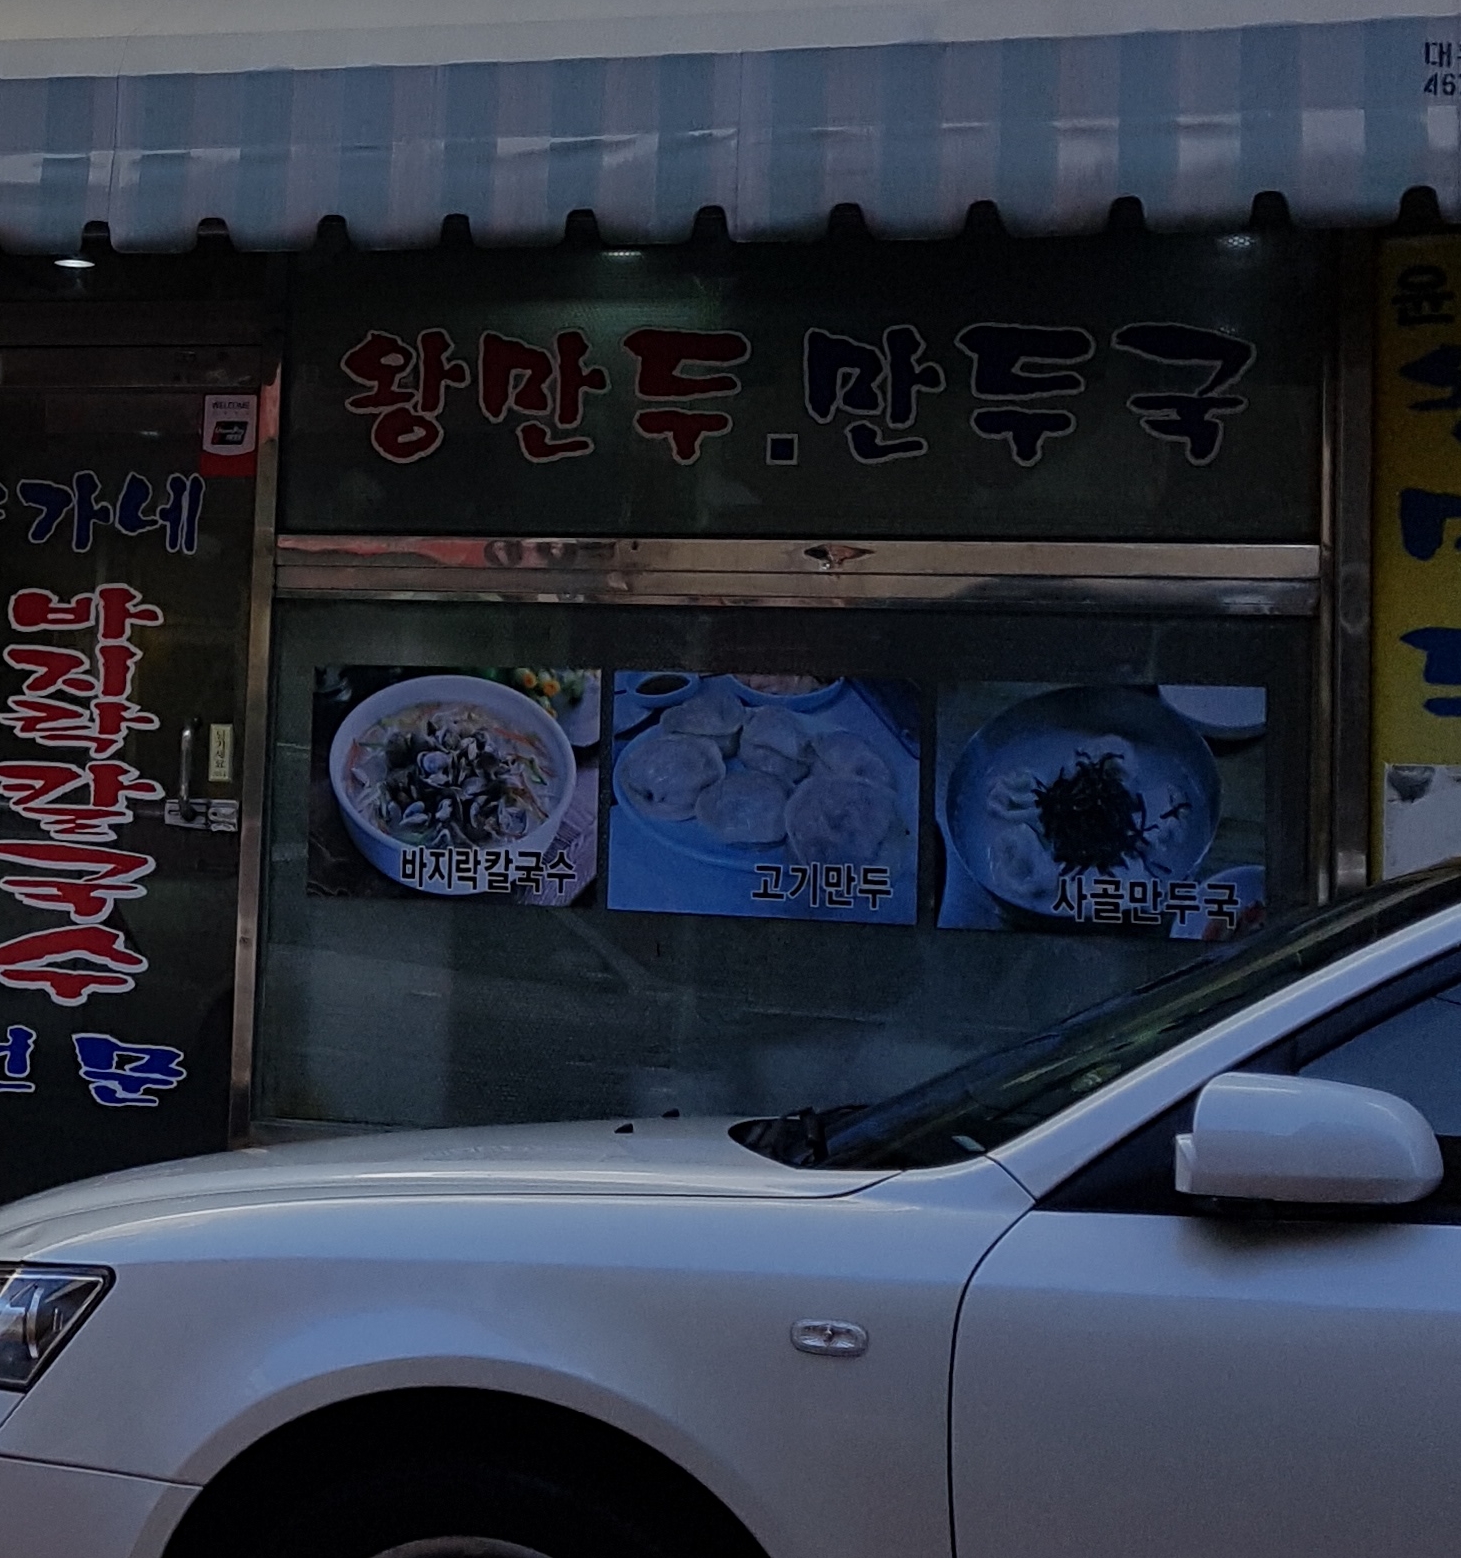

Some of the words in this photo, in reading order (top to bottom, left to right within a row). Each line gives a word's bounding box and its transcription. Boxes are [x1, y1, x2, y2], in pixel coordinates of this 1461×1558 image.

[1423, 41, 1461, 69] 대
[1423, 72, 1461, 96] 46
[400, 846, 577, 895] 바지락칼국수
[751, 862, 894, 911] 고기만두
[1052, 876, 1240, 930] 사골만두국
